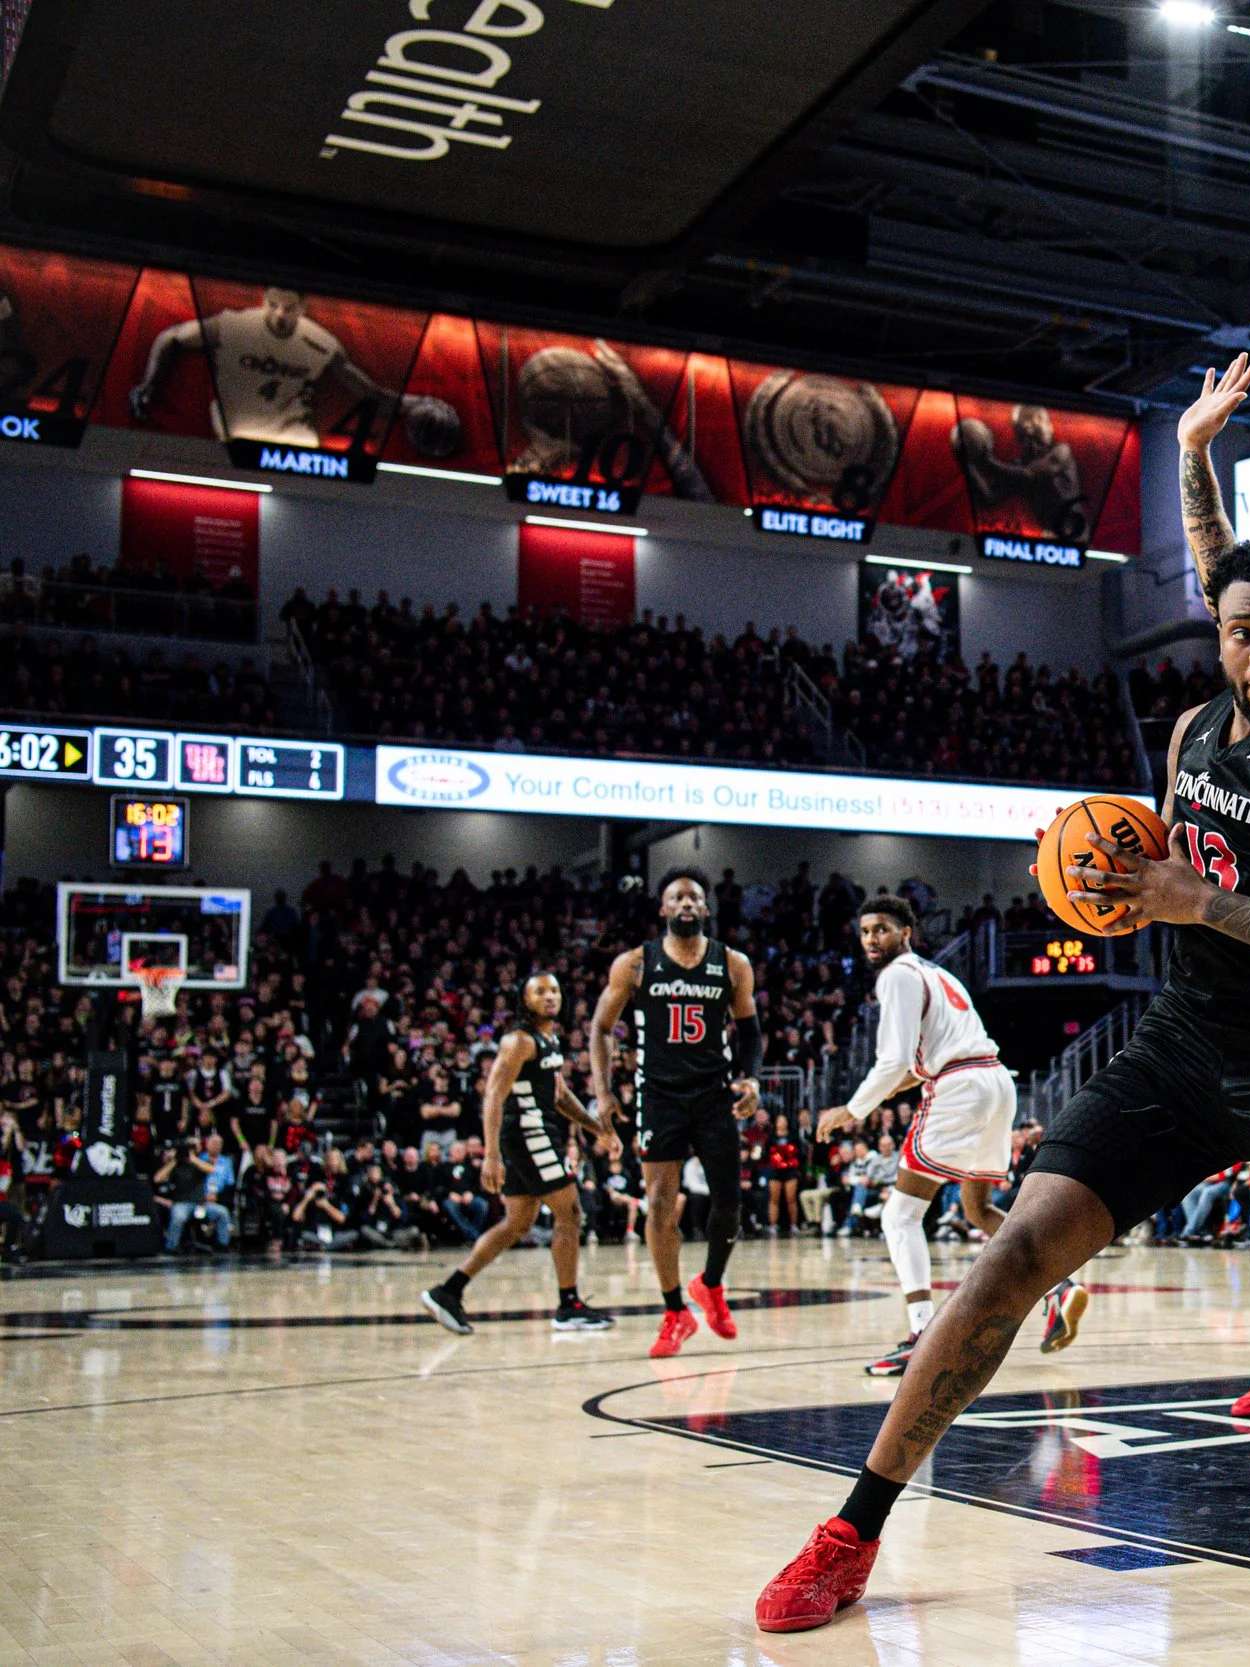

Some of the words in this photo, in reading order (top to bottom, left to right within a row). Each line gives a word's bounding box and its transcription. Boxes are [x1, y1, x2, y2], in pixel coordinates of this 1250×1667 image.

[324, 0, 544, 160] ealth
[259, 448, 349, 478] MARTIN
[526, 480, 594, 508] SWEET
[597, 489, 621, 512] 16
[761, 510, 808, 534] ELITE
[812, 516, 866, 541] EIGHT
[984, 538, 1033, 560] FINAL
[1035, 545, 1081, 566] FOUR
[113, 736, 158, 780] 35
[505, 771, 563, 798] Your
[572, 775, 675, 804] Comfort
[685, 785, 705, 806] is
[713, 784, 759, 809] Our
[768, 788, 883, 816] Business!
[125, 803, 180, 827] 16:02
[138, 827, 173, 862] 13
[1185, 821, 1239, 892] 13
[649, 979, 723, 999] CINCINNATI
[667, 1003, 706, 1043] 15
